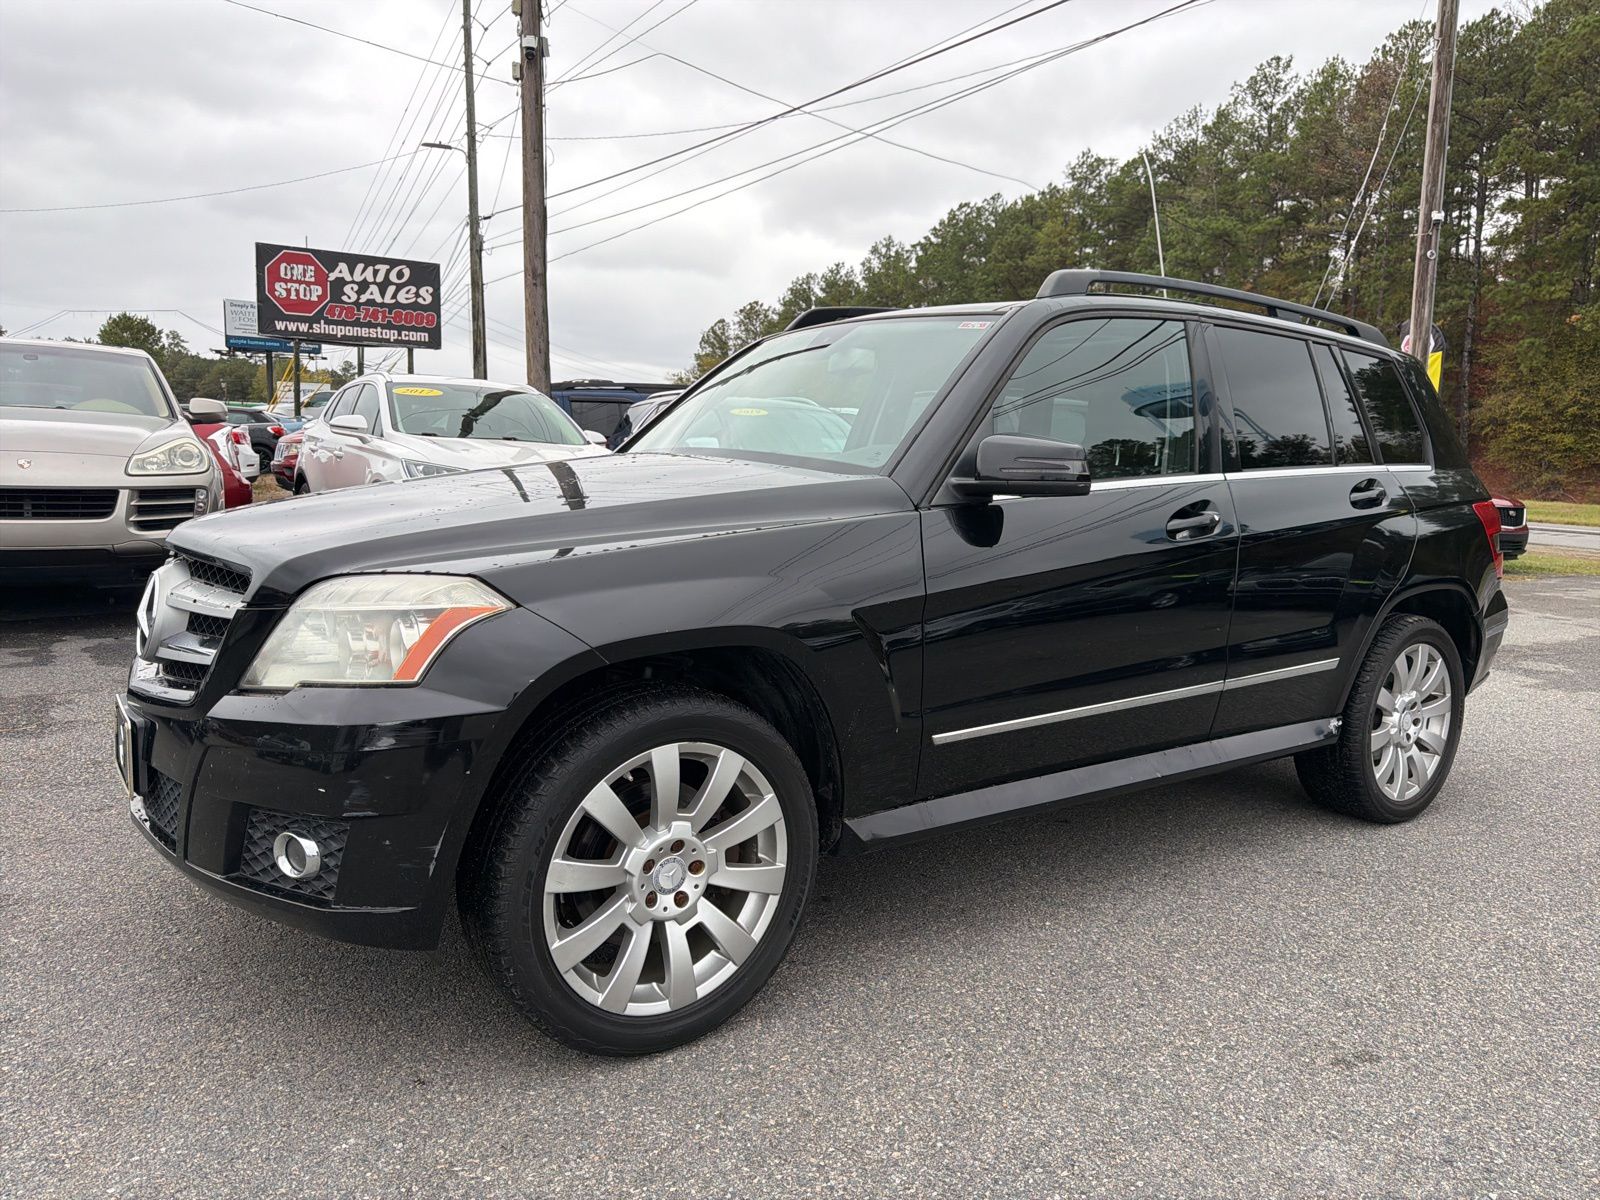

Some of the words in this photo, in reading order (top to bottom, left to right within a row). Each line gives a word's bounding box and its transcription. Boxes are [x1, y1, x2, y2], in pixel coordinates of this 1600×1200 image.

[280, 262, 315, 282] ONE
[328, 262, 411, 284] AUTO
[274, 282, 323, 302] STOP
[341, 284, 434, 305] SALES
[230, 302, 249, 310] Deeply
[324, 303, 437, 328] 478-741-8009
[275, 319, 429, 342] www.shoponestop.com
